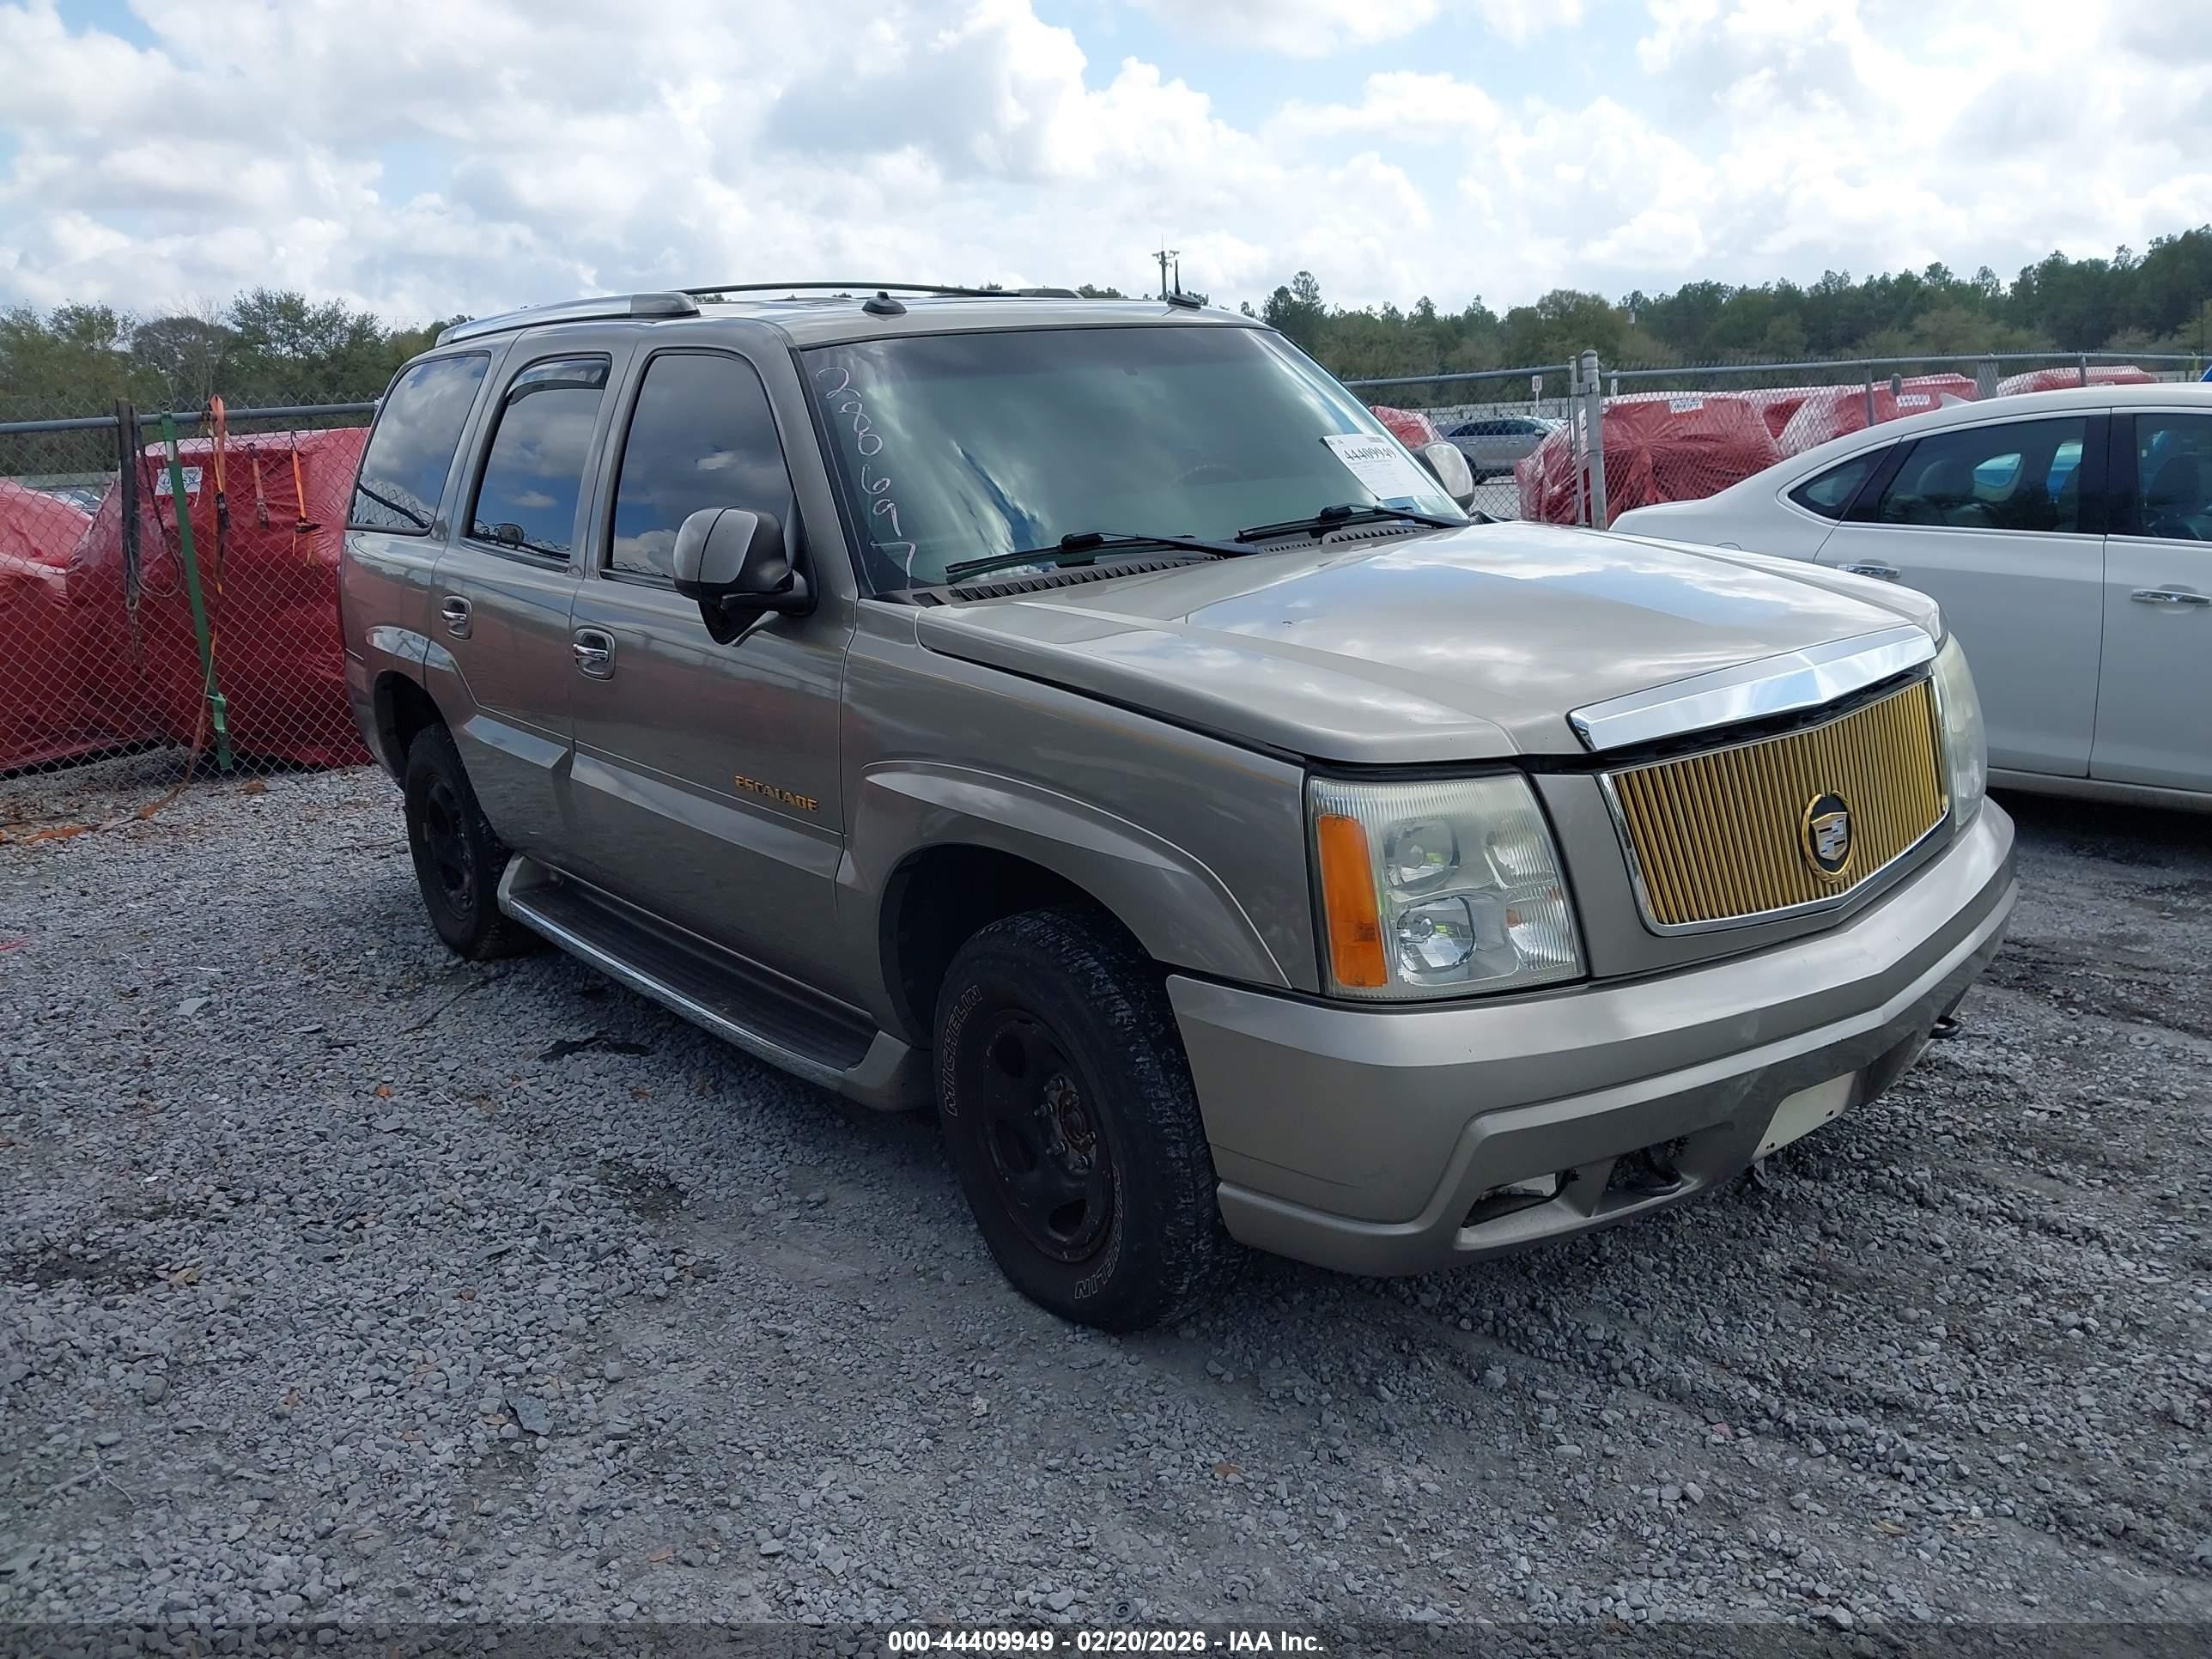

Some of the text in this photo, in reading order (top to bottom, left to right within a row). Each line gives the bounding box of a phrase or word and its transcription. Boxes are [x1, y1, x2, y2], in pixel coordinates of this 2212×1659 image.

[1343, 447, 1398, 461] 44409949
[734, 774, 820, 811] ESCALADE
[940, 984, 982, 1117] MICHELIN
